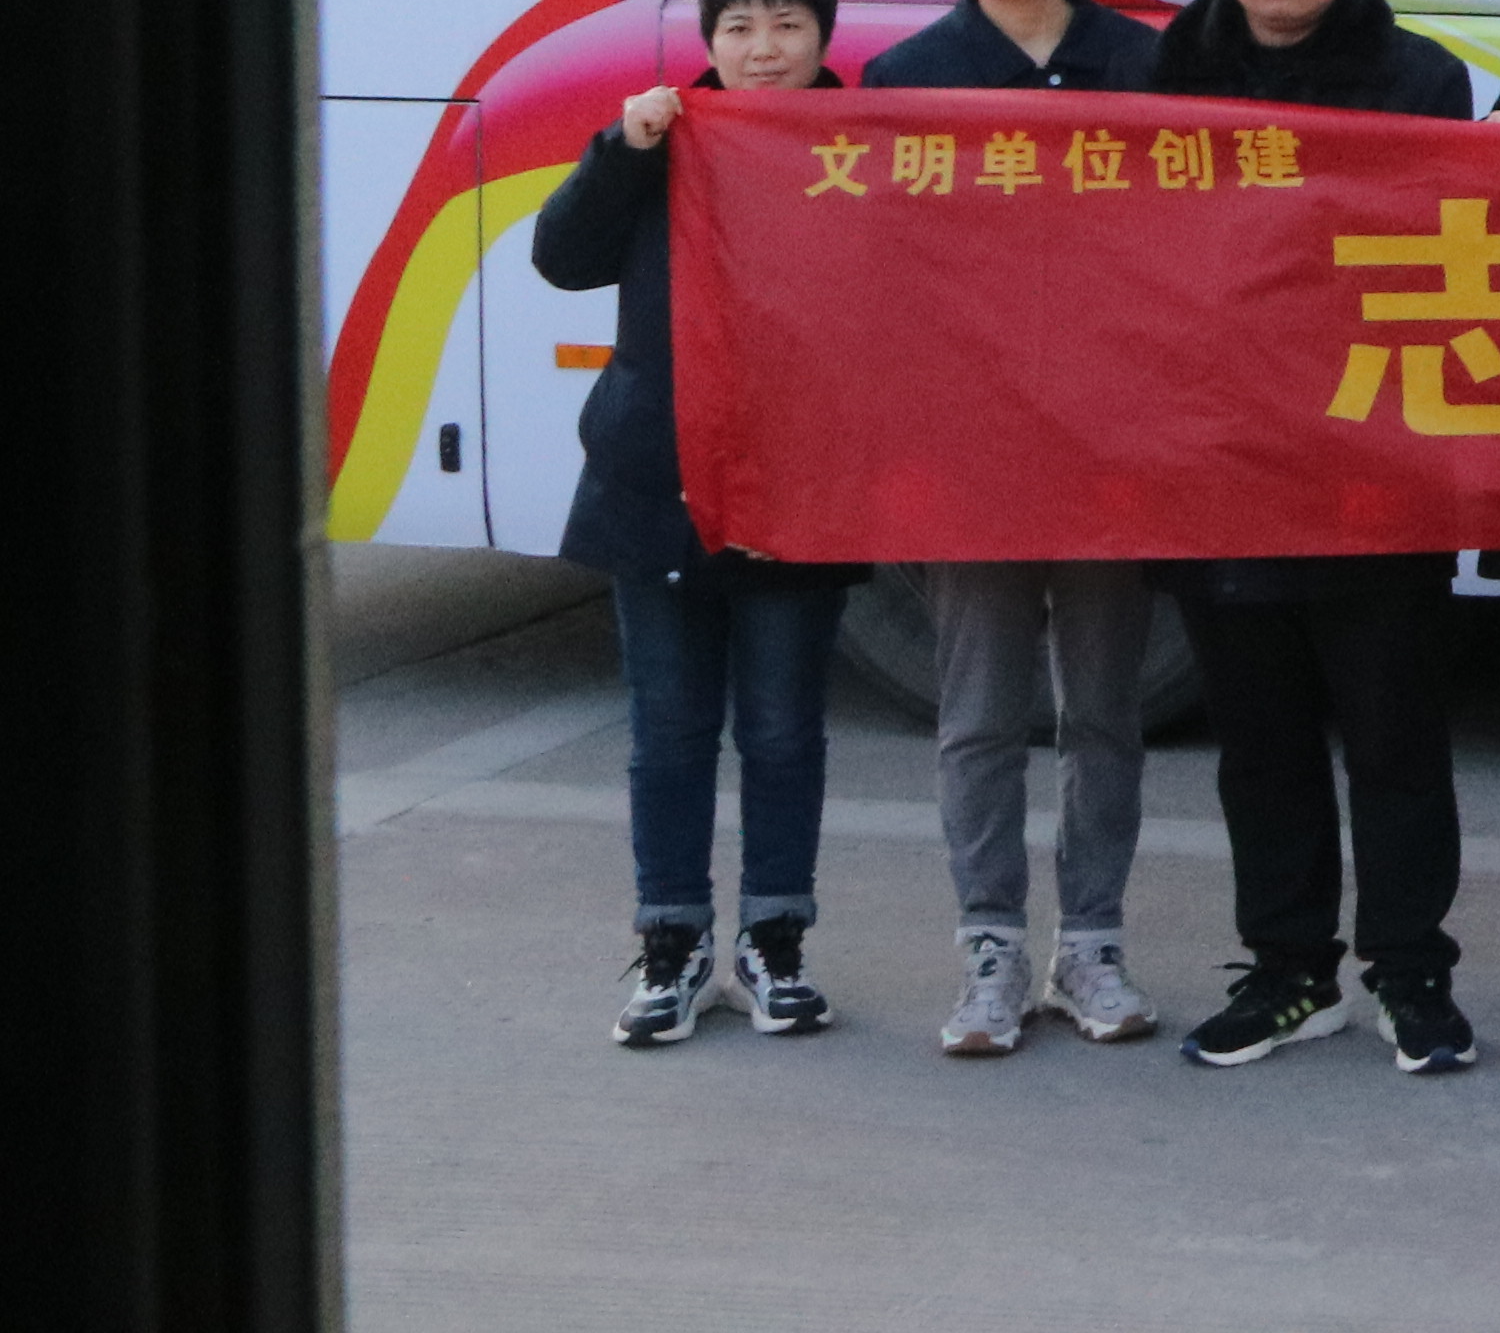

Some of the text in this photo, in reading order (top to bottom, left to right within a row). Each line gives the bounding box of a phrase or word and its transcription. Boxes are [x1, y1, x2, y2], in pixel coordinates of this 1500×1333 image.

[805, 123, 1305, 199] 文明单位创建
